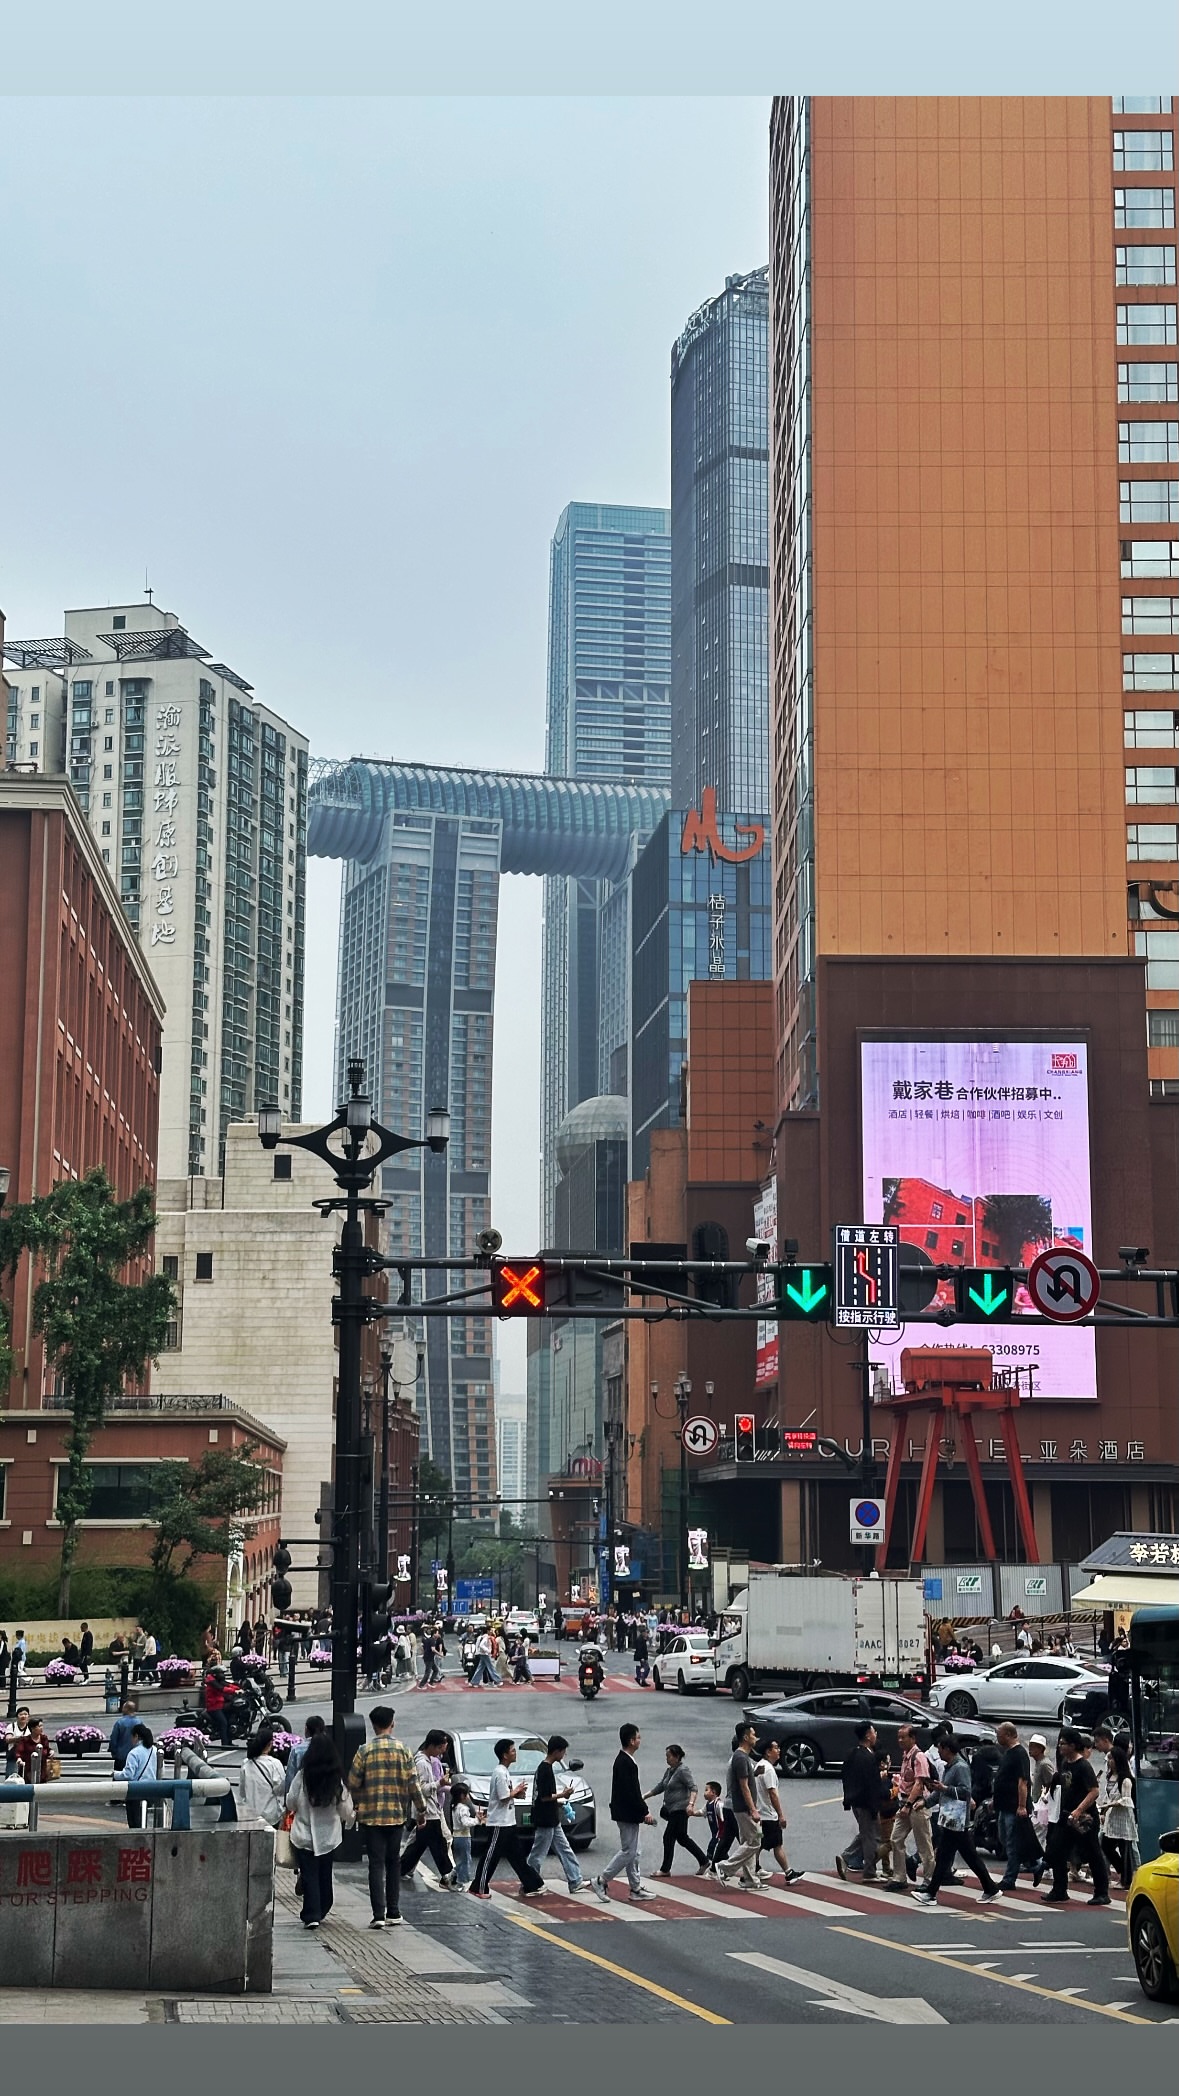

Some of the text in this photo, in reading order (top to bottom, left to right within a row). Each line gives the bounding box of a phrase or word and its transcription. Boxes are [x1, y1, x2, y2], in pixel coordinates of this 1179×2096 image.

[709, 894, 726, 980] 桔子水晶
[893, 1081, 954, 1100] 戴家巷
[888, 1109, 907, 1120] 酒店
[967, 1109, 986, 1120] 咖啡
[991, 1109, 1011, 1120] 酒吧
[1018, 1109, 1037, 1120] 娱乐
[1044, 1109, 1063, 1120] 文创
[841, 1229, 894, 1244] 借道左转
[839, 1310, 897, 1324] 按指示行驶
[1040, 1440, 1145, 1460] 亚朵酒店
[0, 1847, 152, 1887] 爬踩踏
[10, 1887, 148, 1907] OR STEPPING
